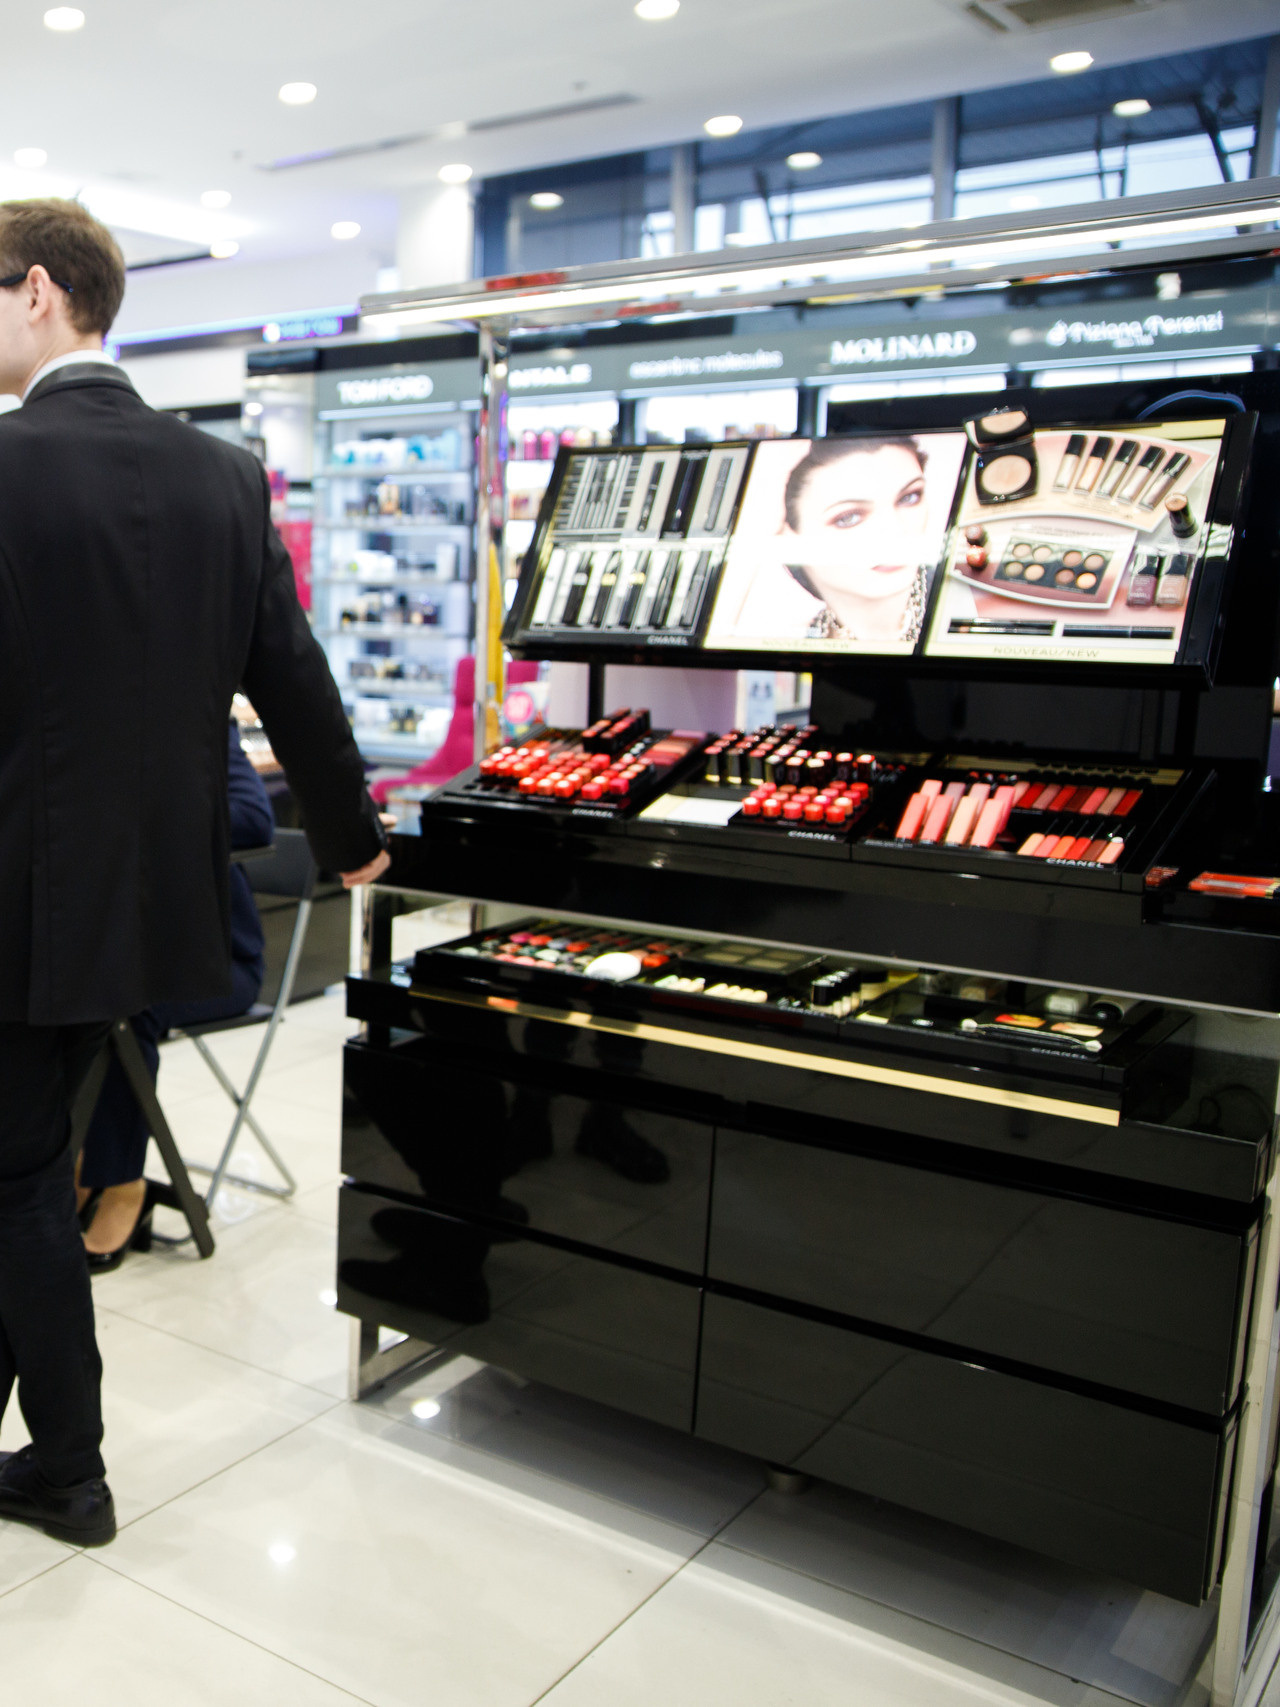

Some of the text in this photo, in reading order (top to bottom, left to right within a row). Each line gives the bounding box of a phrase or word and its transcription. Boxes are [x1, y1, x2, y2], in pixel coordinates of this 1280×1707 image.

[830, 330, 977, 365] MOLINARD
[336, 374, 434, 404] TOM FORD
[646, 634, 689, 647] CHANEL
[992, 644, 1100, 659] NOUVEAU/NEW
[571, 808, 614, 819] CHANEL
[787, 830, 837, 842] CHANEL
[1046, 857, 1105, 869] CHANEL
[1030, 1047, 1090, 1060] CHANEL
